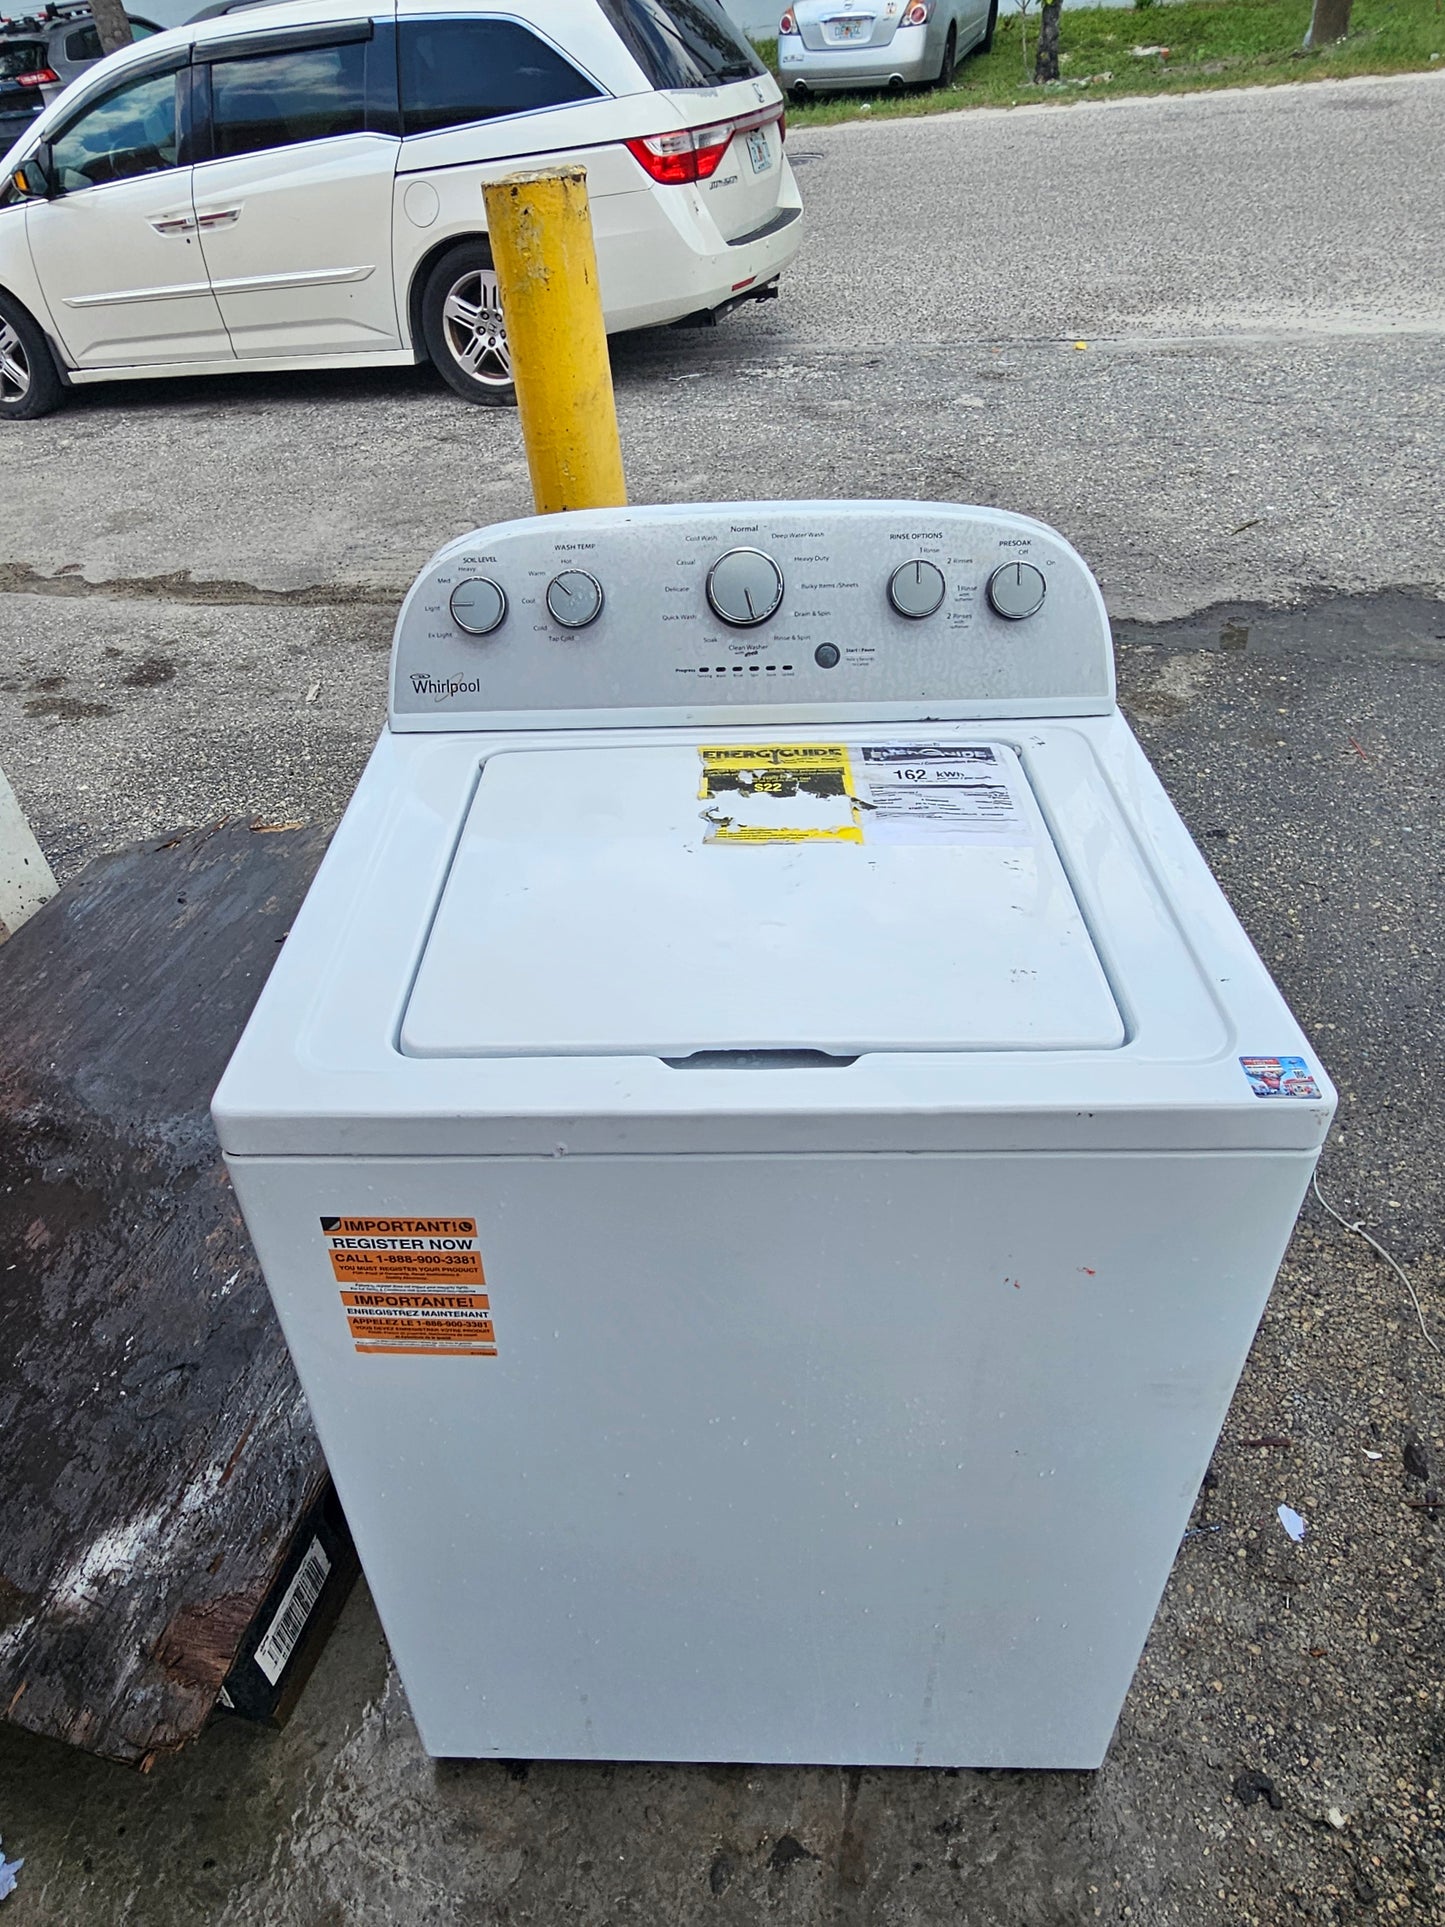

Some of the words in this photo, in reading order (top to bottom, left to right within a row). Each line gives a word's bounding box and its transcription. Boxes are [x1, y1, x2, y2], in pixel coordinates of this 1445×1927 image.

[730, 525, 759, 533] Normal
[412, 678, 480, 697] Whirlpool
[894, 769, 927, 780] 162
[344, 1221, 458, 1232] IMPORTANT!
[332, 1238, 424, 1250] REGISTER
[429, 1239, 473, 1250] NOW
[335, 1254, 373, 1263] CALL
[376, 1255, 476, 1265] 1-888-900-3381
[354, 1295, 474, 1308] IMPORTANTE!
[347, 1308, 420, 1317] ENREGISTREZ
[421, 1310, 489, 1318] MAINTENANT
[353, 1318, 399, 1326] APPELEZ
